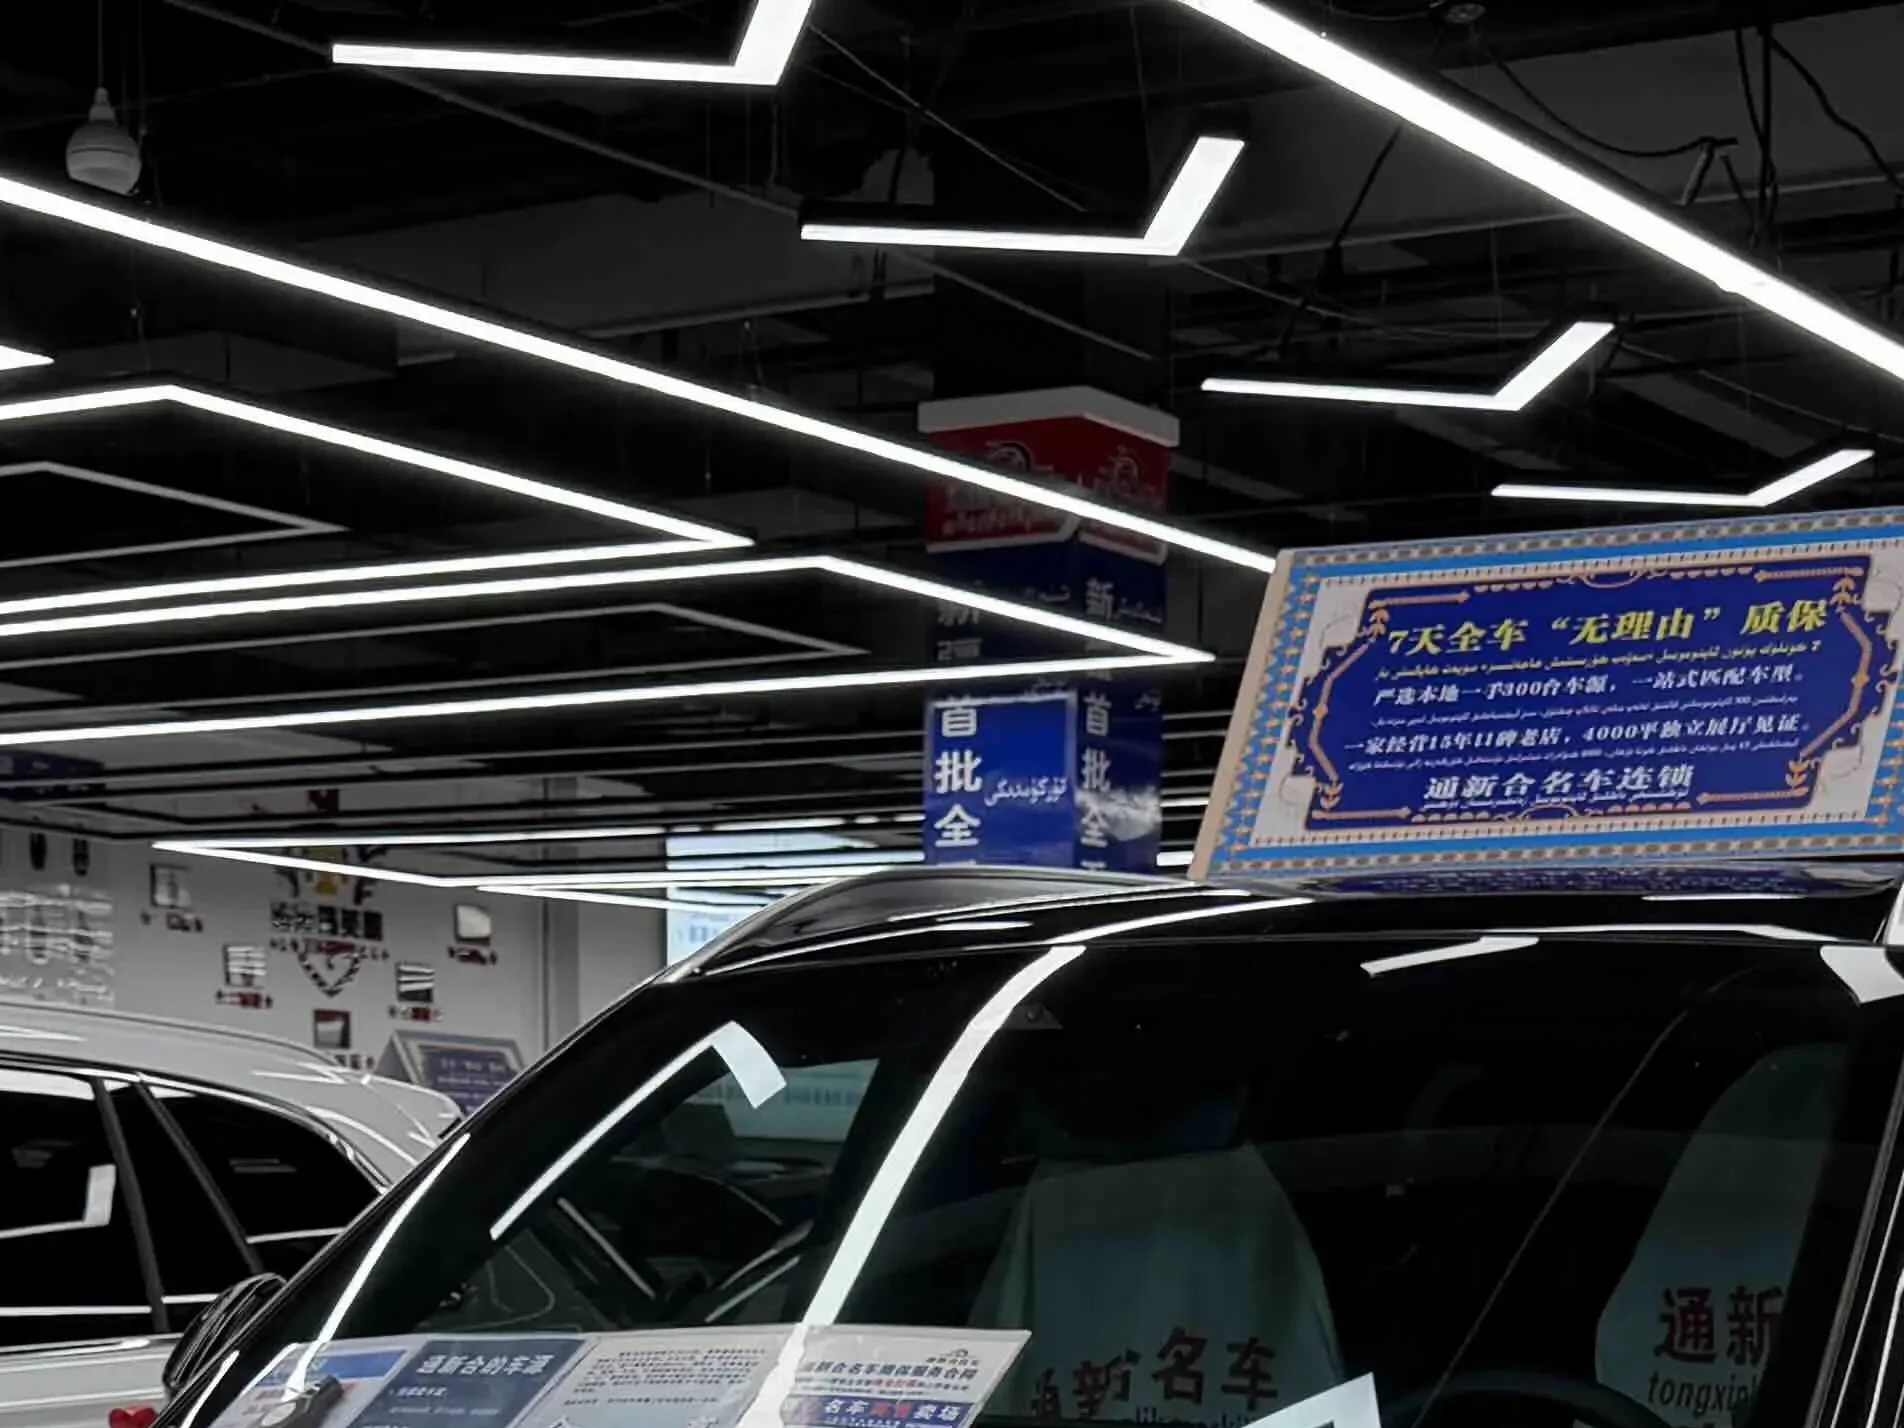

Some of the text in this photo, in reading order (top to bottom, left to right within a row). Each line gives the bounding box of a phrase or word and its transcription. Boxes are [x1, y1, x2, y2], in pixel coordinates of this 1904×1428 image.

[1388, 617, 1529, 657] 7天全车
[1739, 599, 1828, 636] 质保
